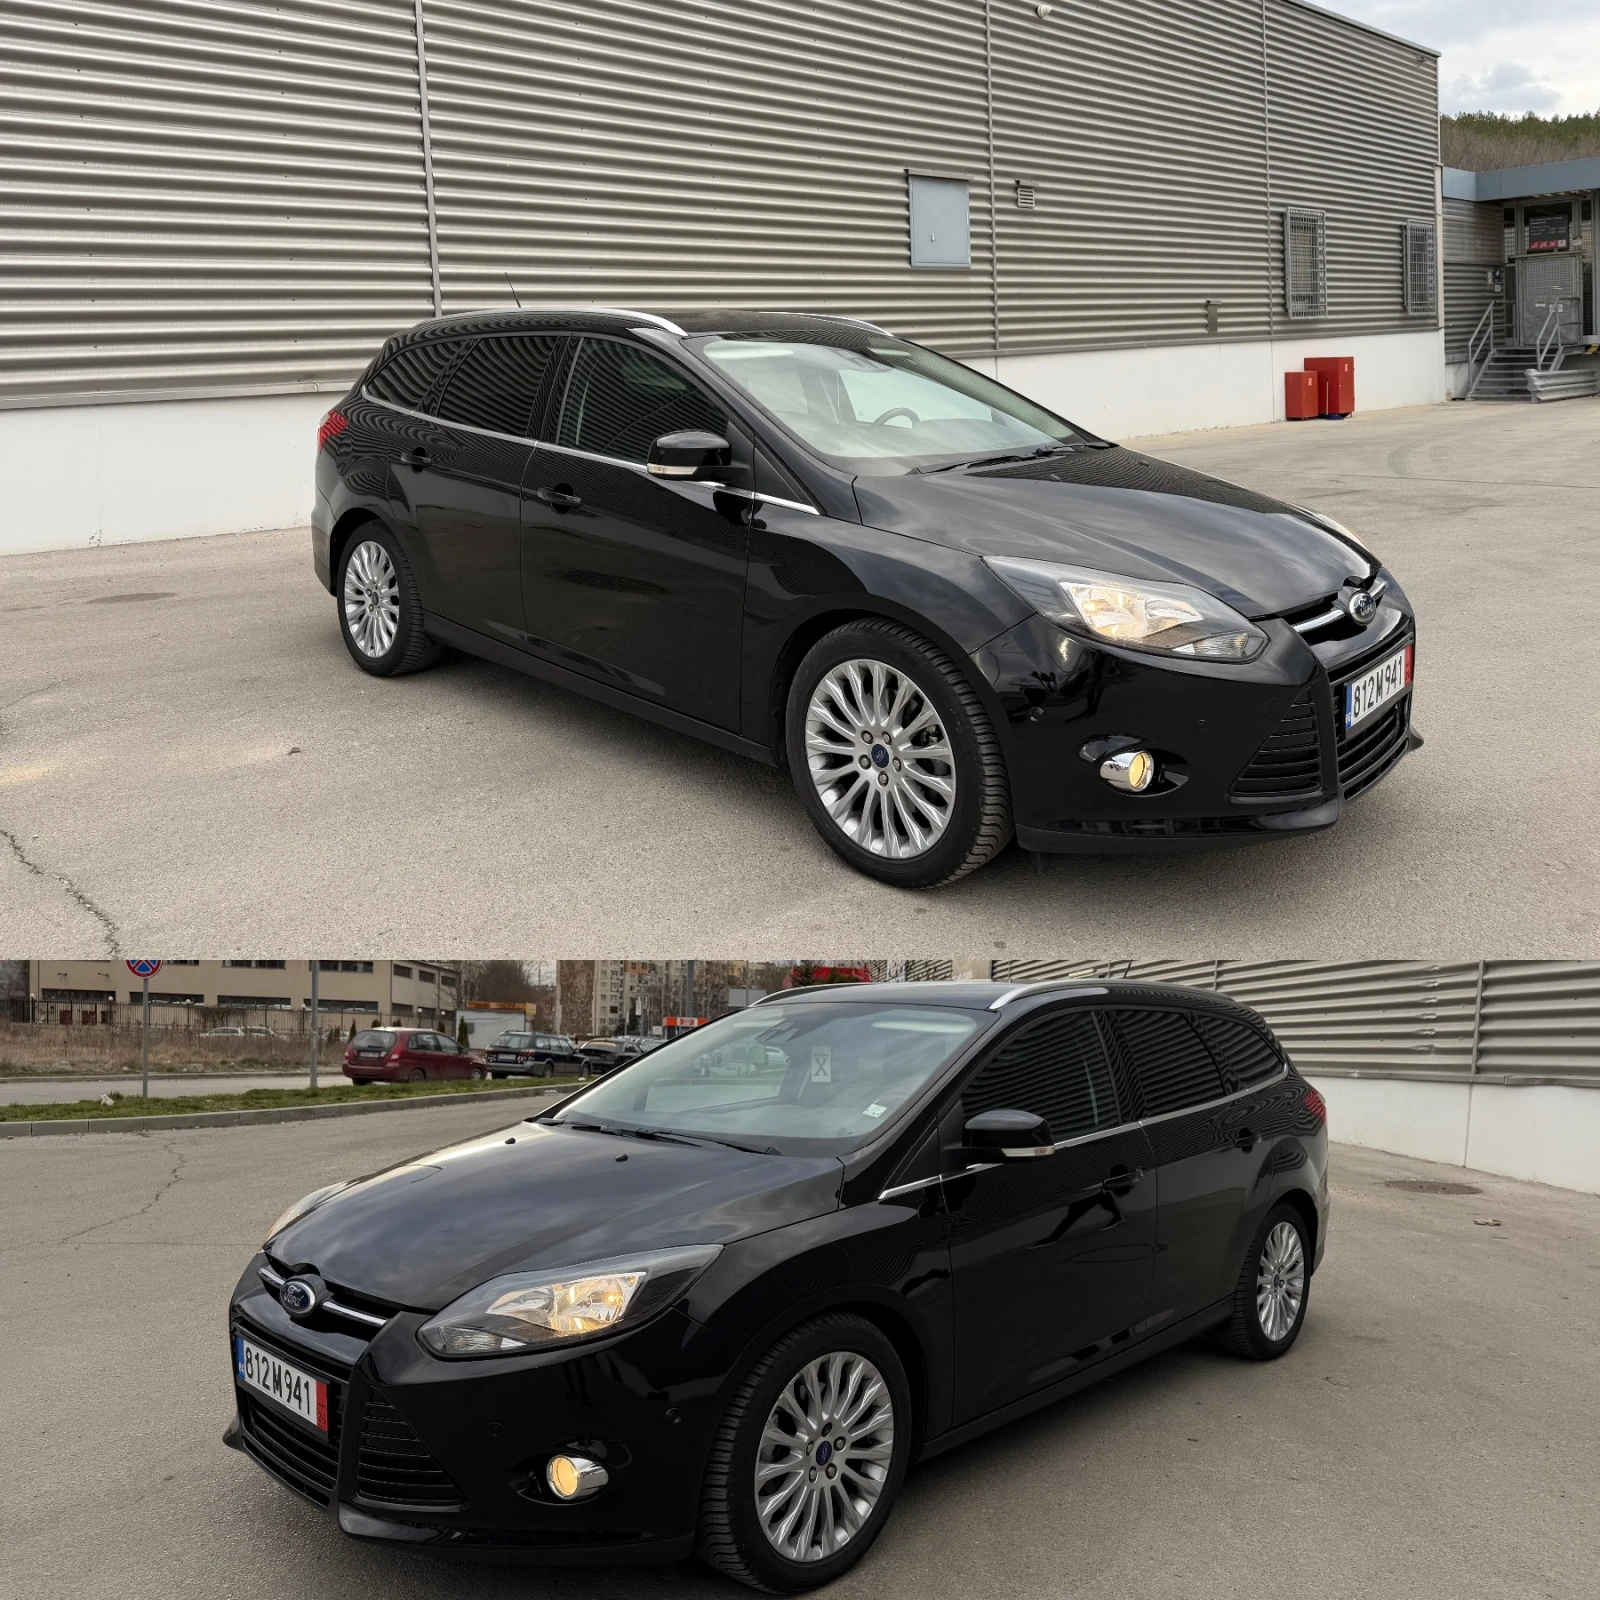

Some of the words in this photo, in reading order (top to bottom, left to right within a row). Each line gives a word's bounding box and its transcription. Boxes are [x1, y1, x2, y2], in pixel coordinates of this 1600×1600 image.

[1354, 656, 1402, 718] 812M941
[813, 1058, 829, 1076] X
[284, 1285, 302, 1307] Ford
[246, 1347, 310, 1416] 812M941
